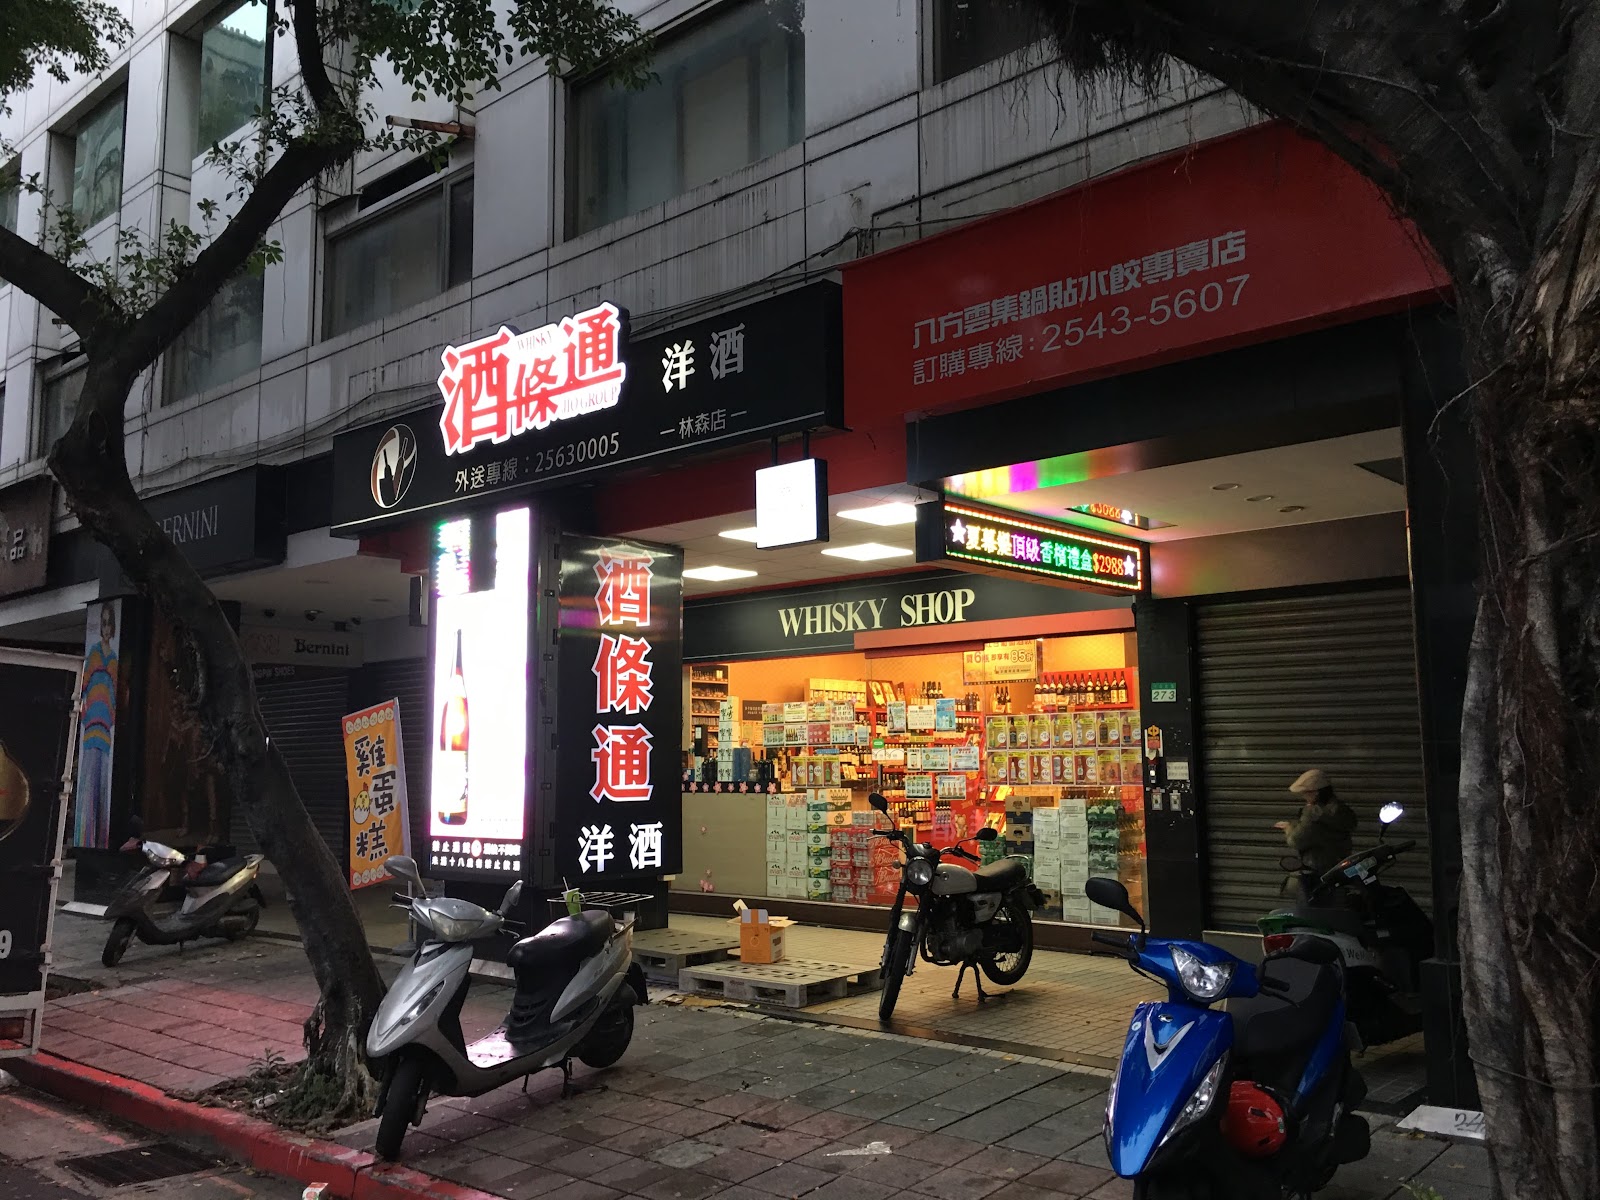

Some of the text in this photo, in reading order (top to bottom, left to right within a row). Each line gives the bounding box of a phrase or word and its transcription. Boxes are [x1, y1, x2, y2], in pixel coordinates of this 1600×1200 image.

[913, 230, 1246, 350] 八方雲集鍋貼水餃專賣店
[517, 330, 553, 352] WHISKY
[440, 307, 622, 452] 酒條通
[156, 505, 219, 545] ERNINI
[778, 588, 976, 638] WHISKY SHOP
[294, 638, 350, 656] Bernini
[591, 545, 655, 803] 酒條通
[1153, 691, 1175, 700] 273
[354, 735, 396, 862] 雞蛋糕
[578, 821, 664, 873] 洋酒
